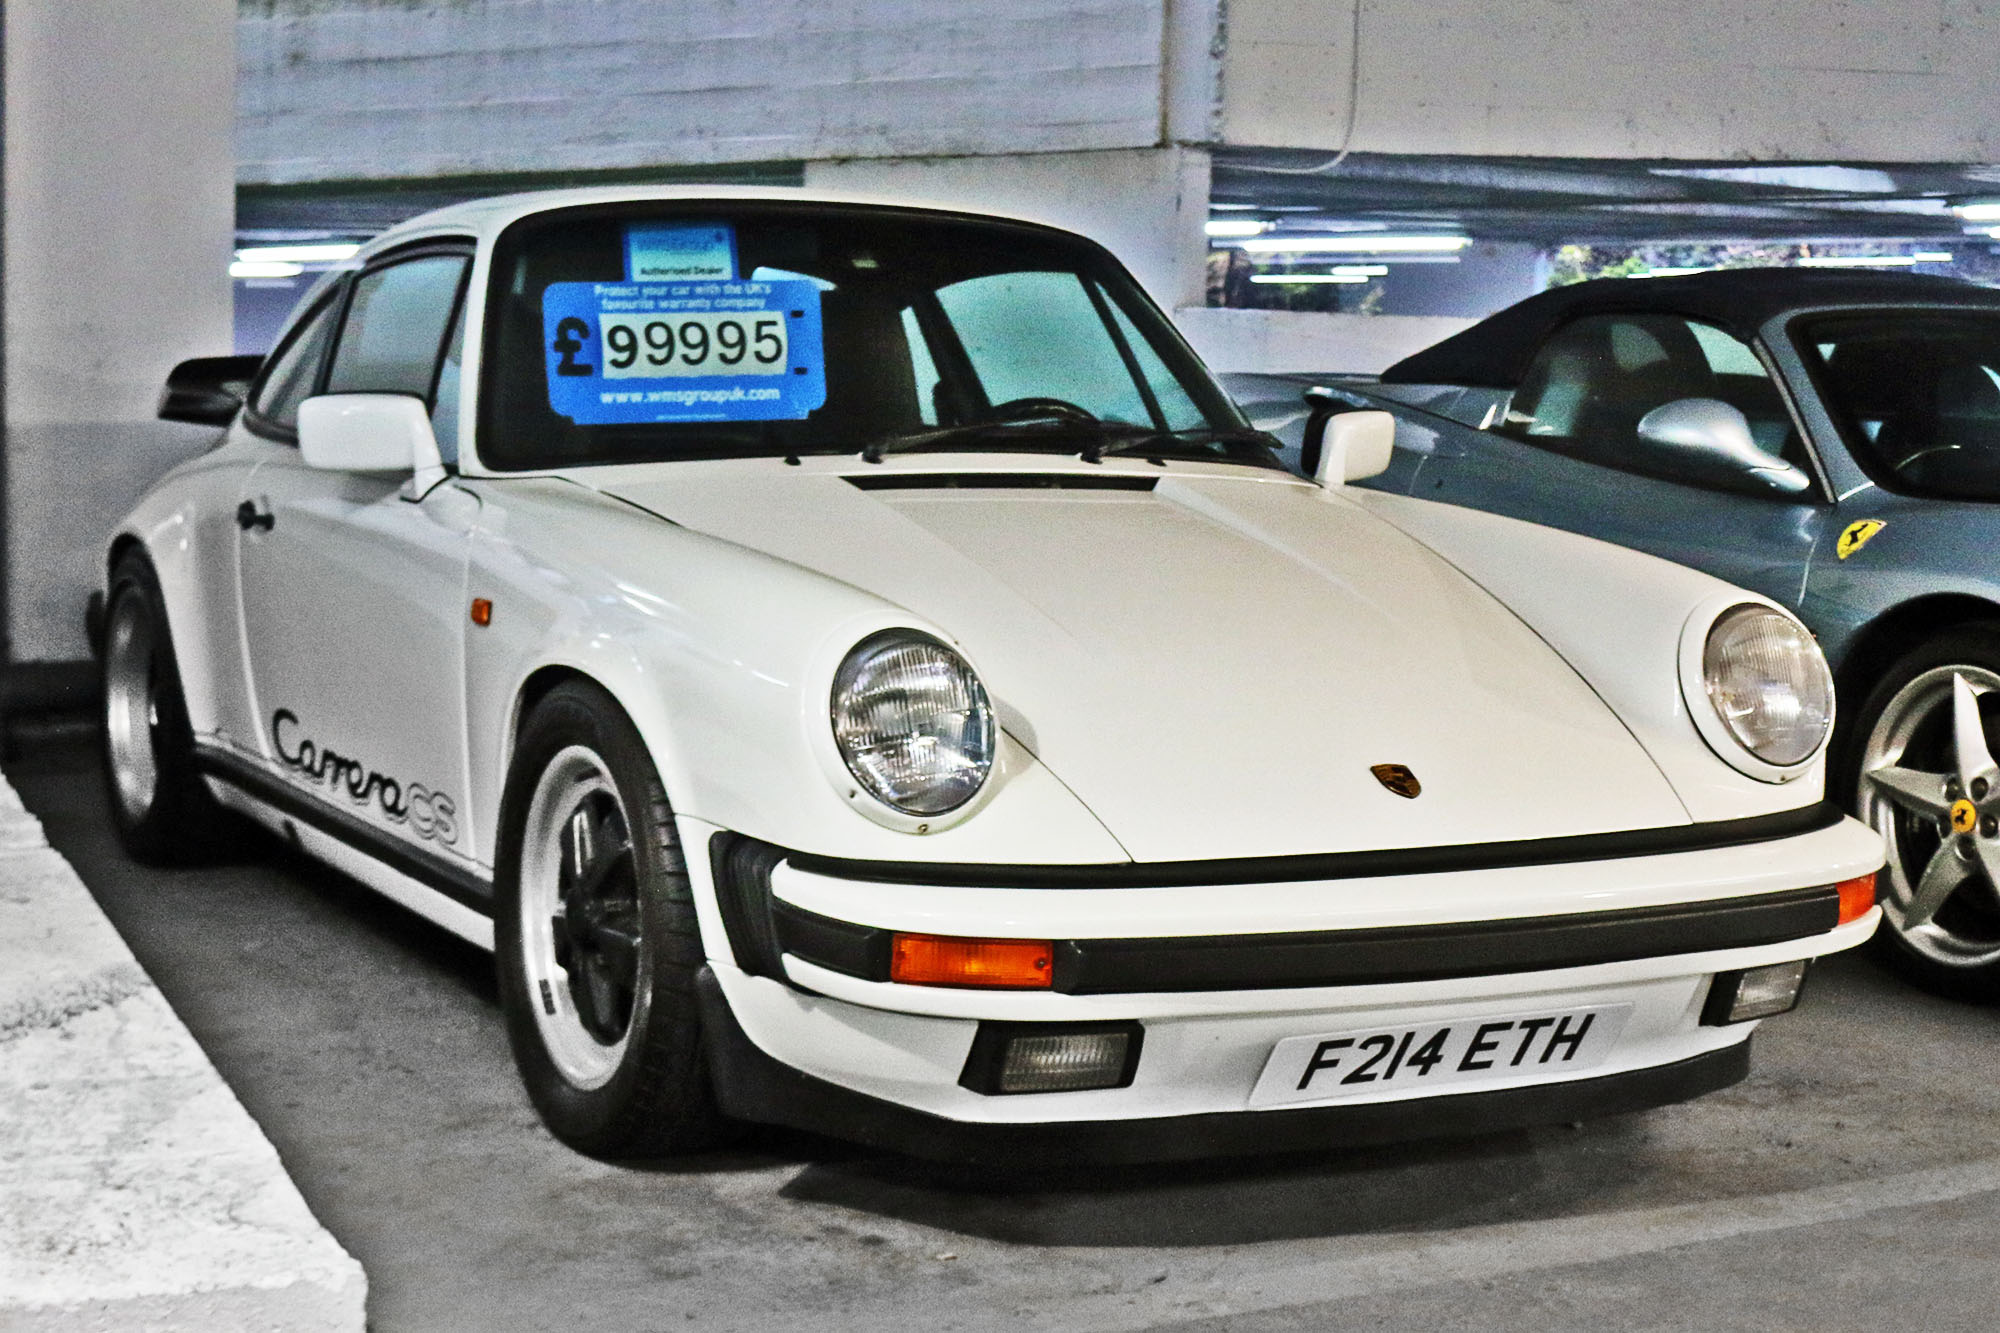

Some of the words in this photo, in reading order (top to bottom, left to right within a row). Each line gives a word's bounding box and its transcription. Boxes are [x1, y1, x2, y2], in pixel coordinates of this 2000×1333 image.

[694, 266, 723, 275] Dealer
[594, 284, 639, 296] Protect
[642, 286, 669, 298] your
[671, 286, 690, 296] car
[694, 285, 721, 296] with
[723, 284, 742, 295] the
[658, 298, 711, 310] warranty
[714, 298, 766, 310] company
[554, 317, 593, 376] £
[607, 320, 783, 369] 99995
[600, 387, 780, 406] www.wmsgroupuk.com
[272, 708, 409, 817] Carrera
[1296, 1027, 1451, 1091] F214
[1456, 1013, 1596, 1072] ETH
